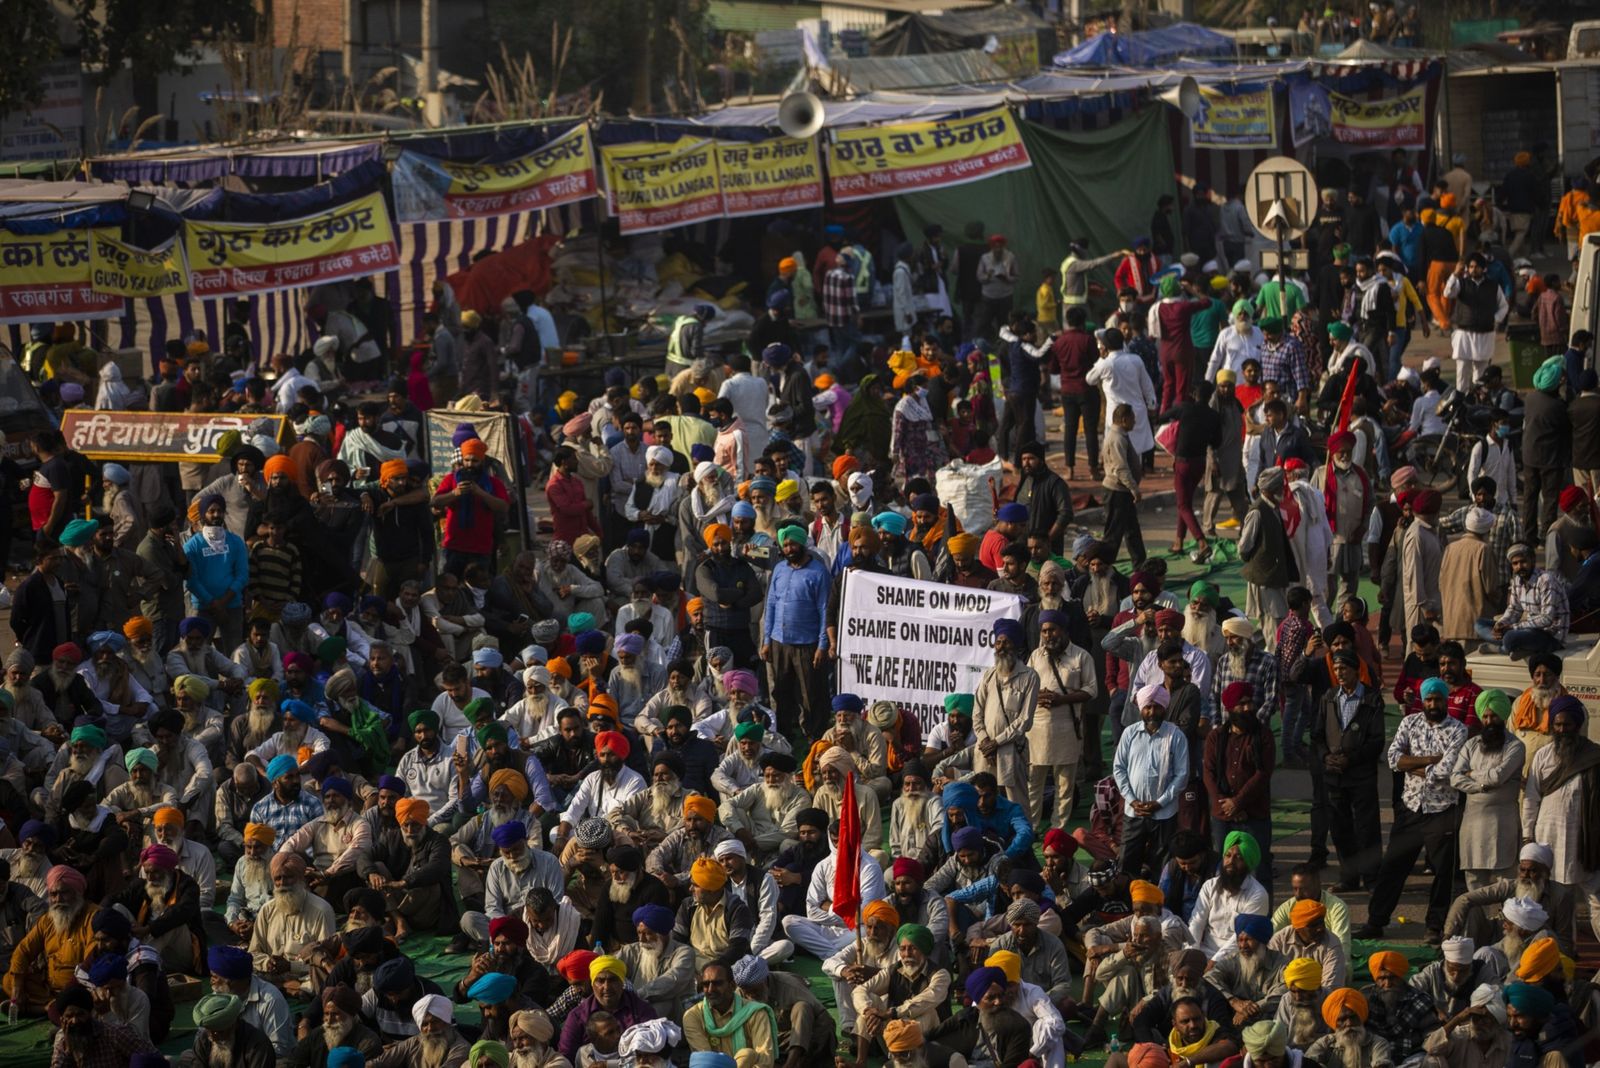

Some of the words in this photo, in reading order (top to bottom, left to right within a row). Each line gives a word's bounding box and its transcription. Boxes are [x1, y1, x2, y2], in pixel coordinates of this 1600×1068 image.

[652, 186, 670, 202] KA
[670, 175, 715, 199] LANGAR
[721, 172, 752, 189] GURU
[754, 170, 770, 184] KA
[771, 164, 815, 183] LANGAR
[261, 224, 305, 250] का
[95, 268, 129, 290] GURU
[192, 271, 227, 293] दिल्ली
[357, 243, 392, 266] कमेटी
[9, 284, 74, 307] रकाबगंज
[71, 414, 180, 451] हरियाणा
[877, 585, 925, 608] SHAME
[929, 590, 950, 610] ON
[847, 617, 896, 639] SHAME
[900, 622, 920, 642] ON
[924, 624, 973, 647] INDIAN
[874, 656, 898, 688] ARE
[902, 658, 957, 693] FARMERS
